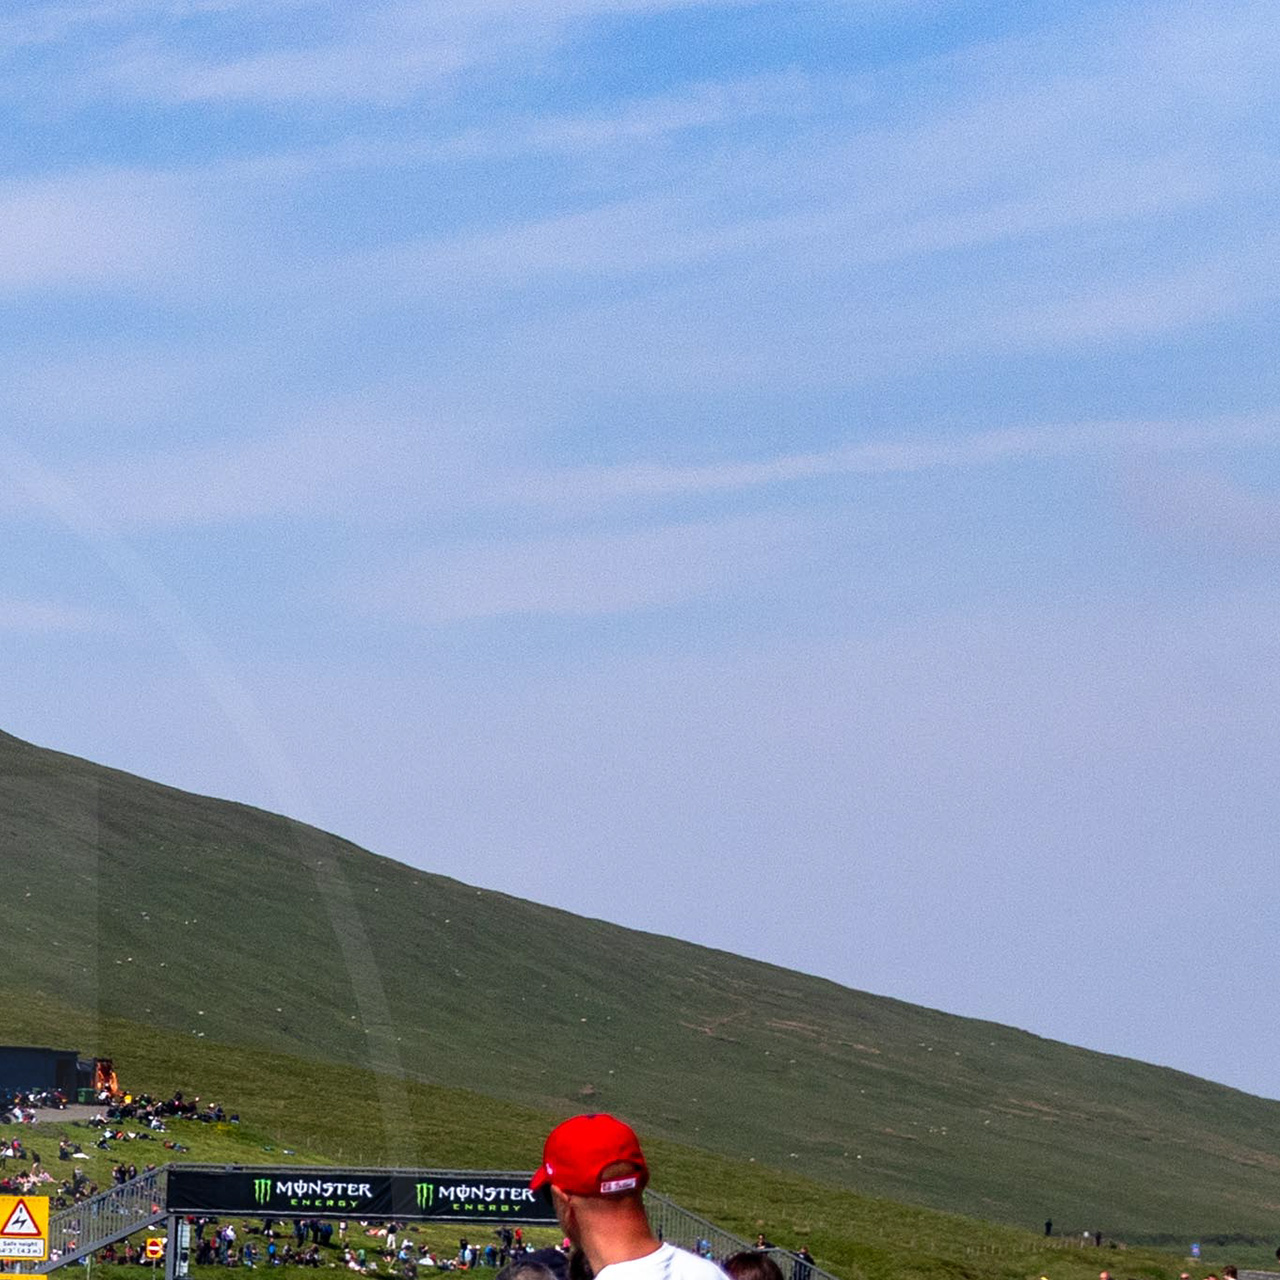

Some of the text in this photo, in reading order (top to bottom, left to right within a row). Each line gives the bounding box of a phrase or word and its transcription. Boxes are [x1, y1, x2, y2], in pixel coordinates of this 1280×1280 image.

[276, 1179, 372, 1197] MONSTER
[438, 1184, 536, 1202] MONSTER
[290, 1199, 359, 1208] ENERGY
[452, 1203, 521, 1212] ENERGY
